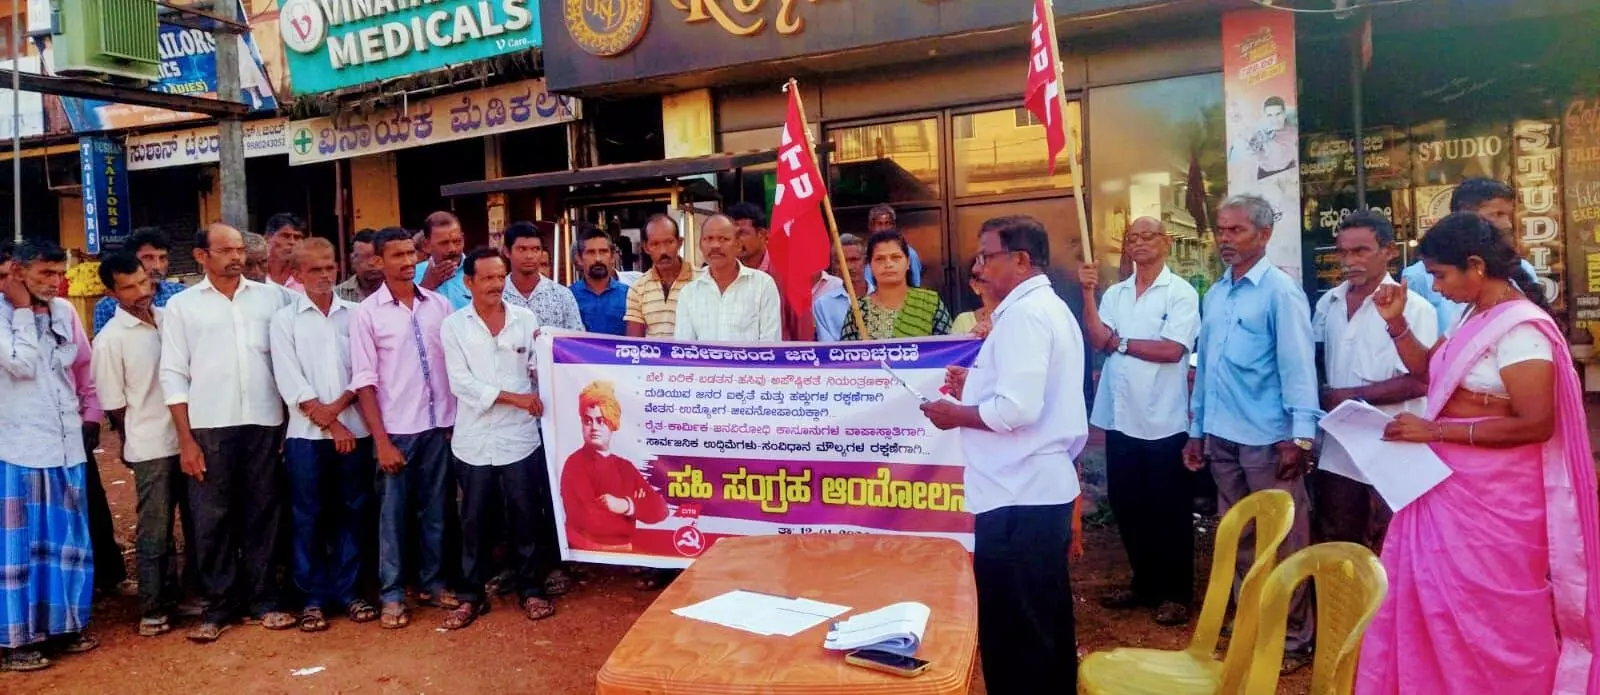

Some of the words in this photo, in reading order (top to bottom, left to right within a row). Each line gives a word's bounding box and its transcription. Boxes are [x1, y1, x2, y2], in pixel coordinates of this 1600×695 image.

[157, 29, 216, 59] AILORS
[326, 0, 532, 70] MEDICALS
[1418, 136, 1502, 161] STUDIO
[615, 345, 661, 364] ಸ್ವಾಮಿ
[670, 346, 775, 361] ವಿವೇಕಾನಂದ
[785, 348, 820, 366] ಜನ್ಮ
[829, 344, 920, 362] ದಿನಾಚರಣೆ
[760, 391, 785, 404] ಮತ್ತು
[667, 464, 713, 498] ಸಹಿ
[722, 467, 812, 513] ಸಂಗ್ರಹ
